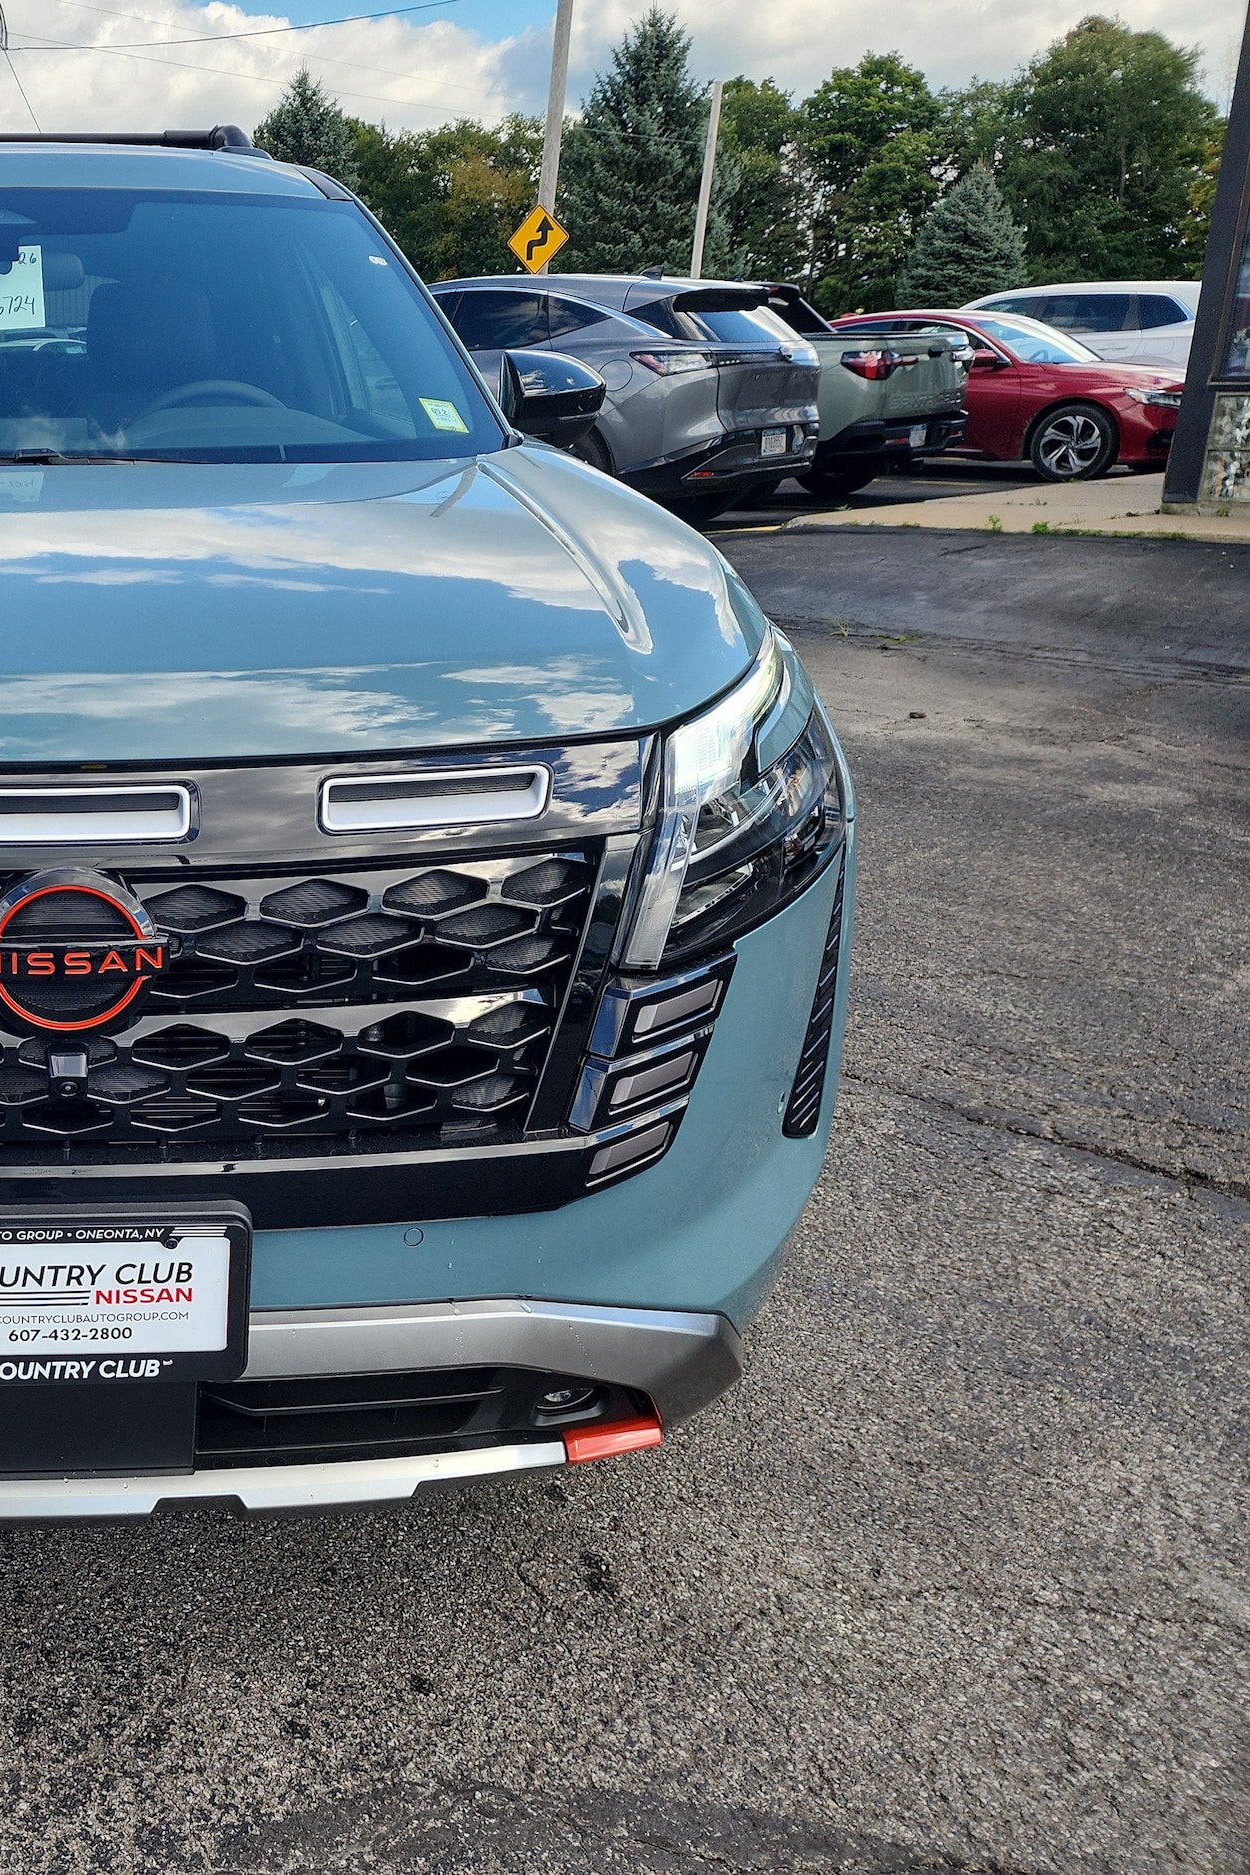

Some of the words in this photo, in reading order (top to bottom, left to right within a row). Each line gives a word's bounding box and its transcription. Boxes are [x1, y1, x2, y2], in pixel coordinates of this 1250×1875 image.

[16, 1230, 64, 1240] GROUP
[115, 1262, 193, 1285] CLUB
[95, 1288, 193, 1305] NISSAN
[8, 1327, 133, 1342] 607-432-2800
[98, 1359, 161, 1379] CLUB
